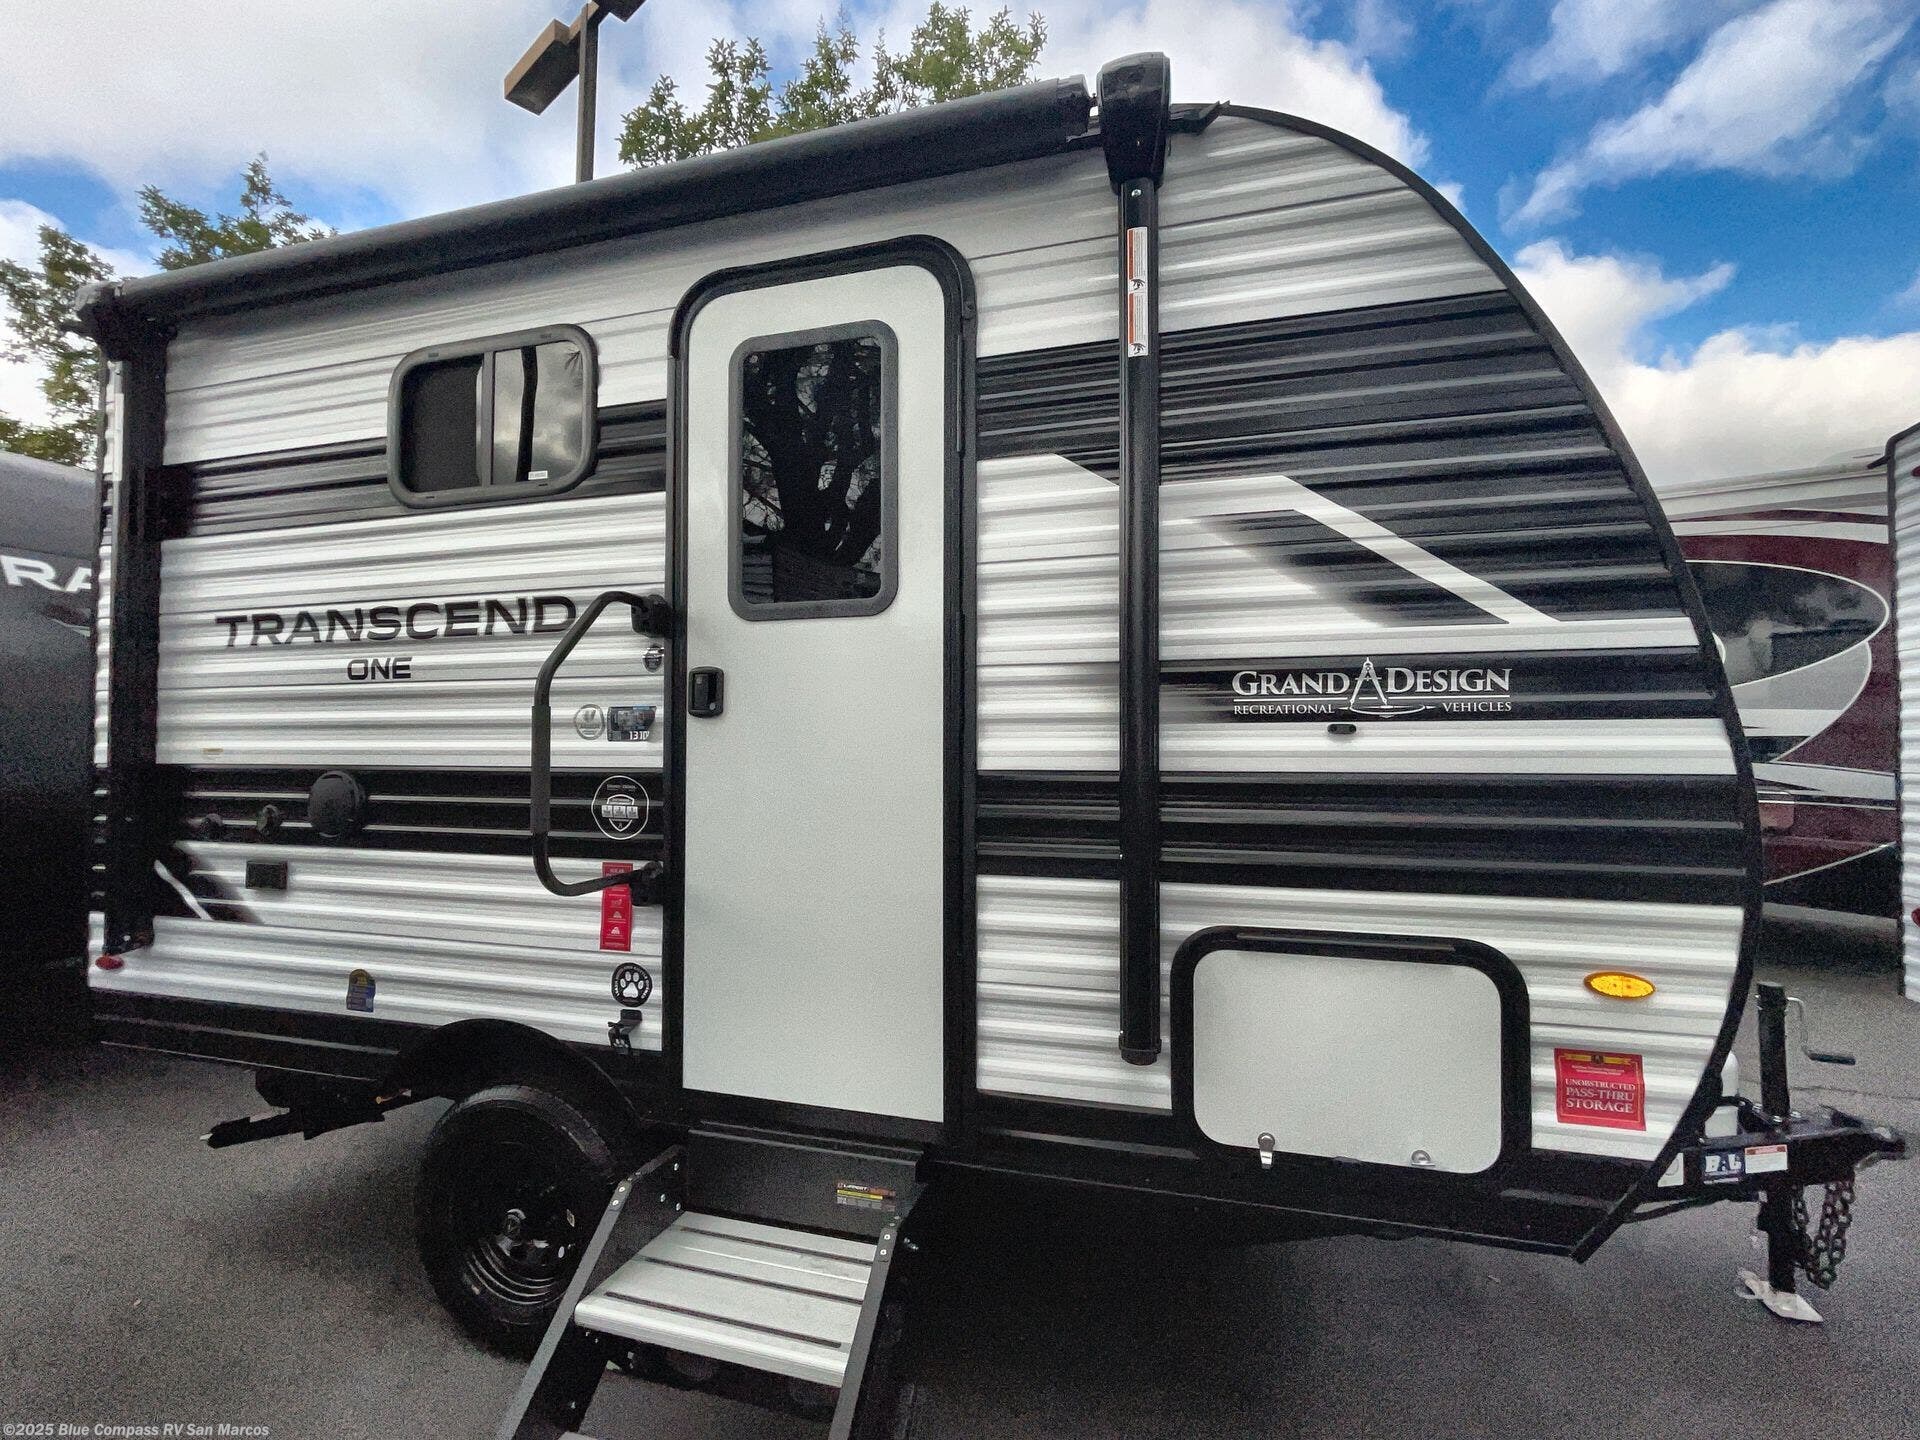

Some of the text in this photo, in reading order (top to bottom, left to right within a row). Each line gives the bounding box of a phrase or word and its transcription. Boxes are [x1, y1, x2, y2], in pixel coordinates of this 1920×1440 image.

[215, 595, 577, 648] TRANSCEND
[347, 656, 414, 681] ONE
[1232, 668, 1513, 695] GRAND DESIGN
[1233, 701, 1512, 715] RECREATIONAL VEHICLES
[1565, 1078, 1636, 1091] UNOBSTRUCTED
[1566, 1087, 1635, 1101] PASS-THRU
[1566, 1098, 1634, 1113] STORAGE
